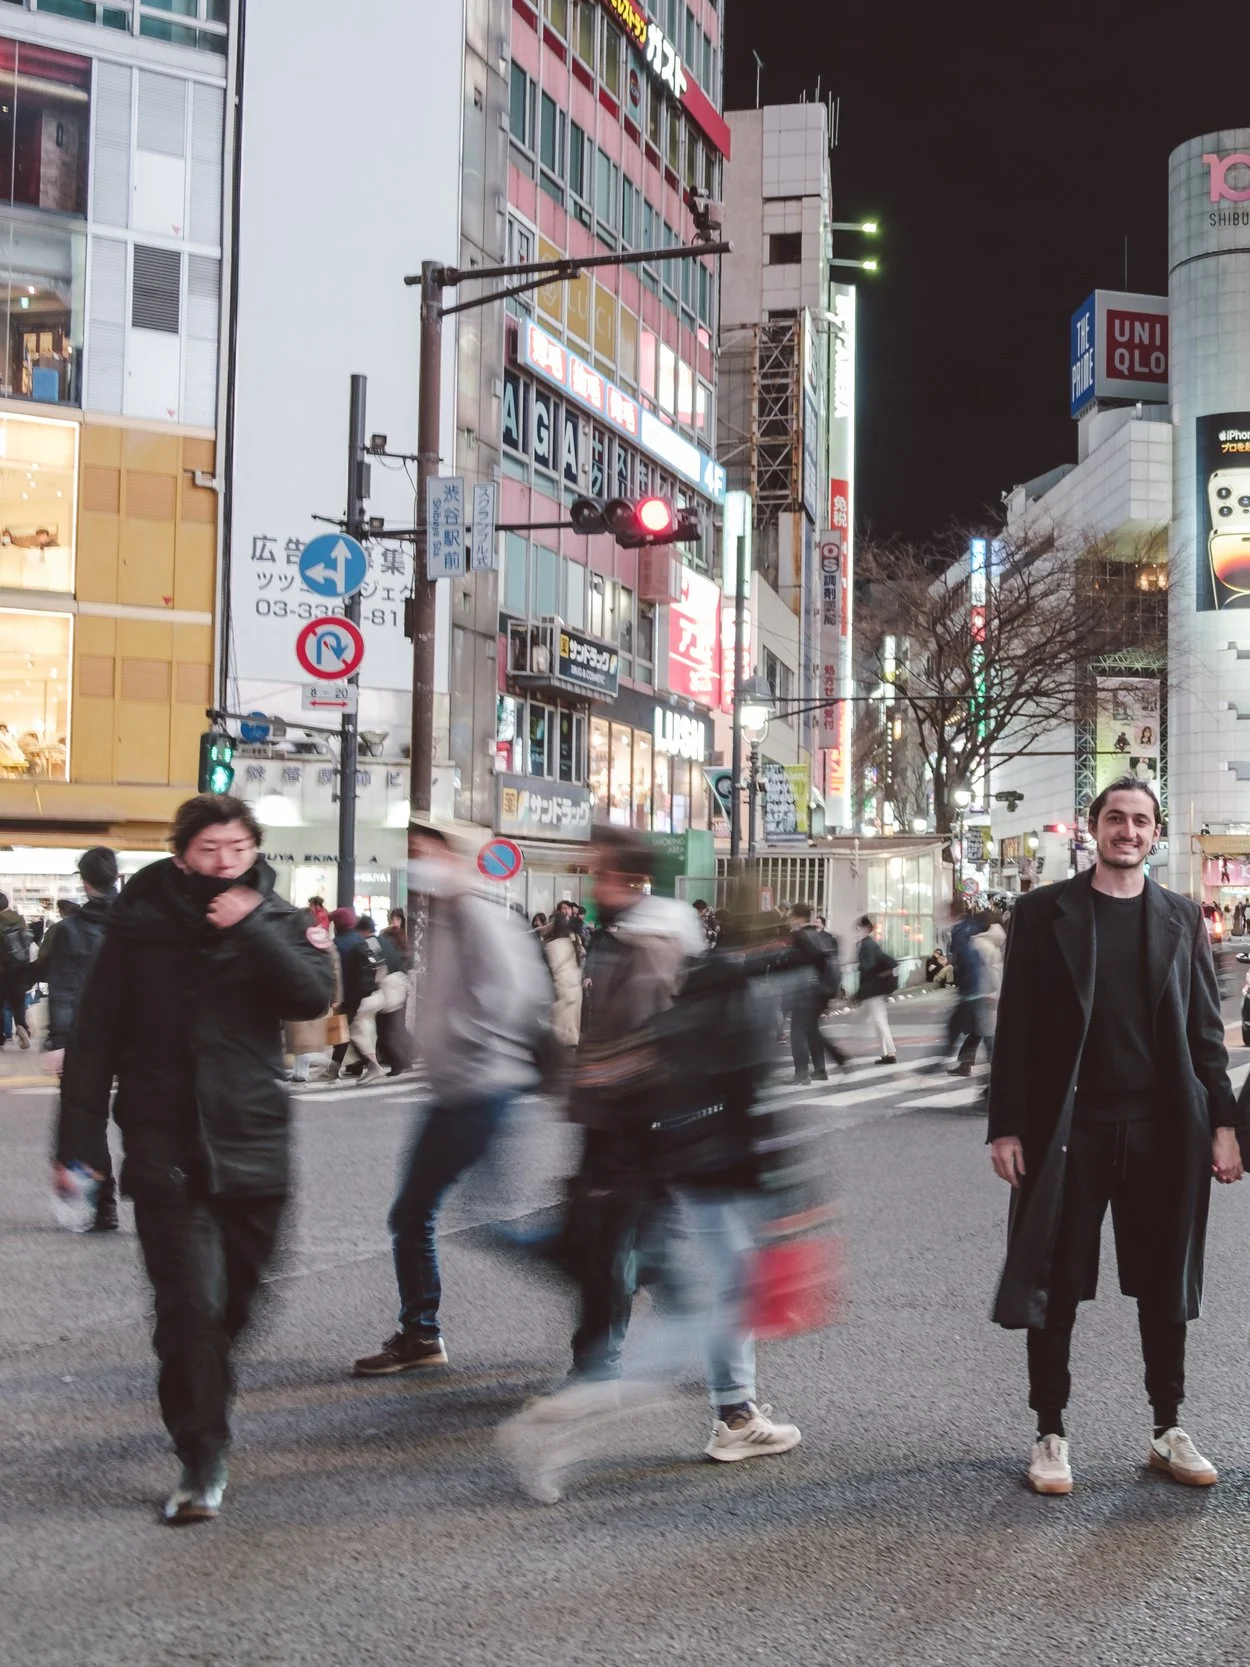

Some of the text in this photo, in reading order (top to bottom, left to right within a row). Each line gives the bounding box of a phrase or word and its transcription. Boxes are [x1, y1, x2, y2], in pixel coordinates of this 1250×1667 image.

[1114, 318, 1161, 347] UNI
[1114, 347, 1166, 376] QLO
[704, 459, 724, 497] 4F
[444, 484, 460, 570] 渋谷駅前
[655, 706, 705, 762] LUSH
